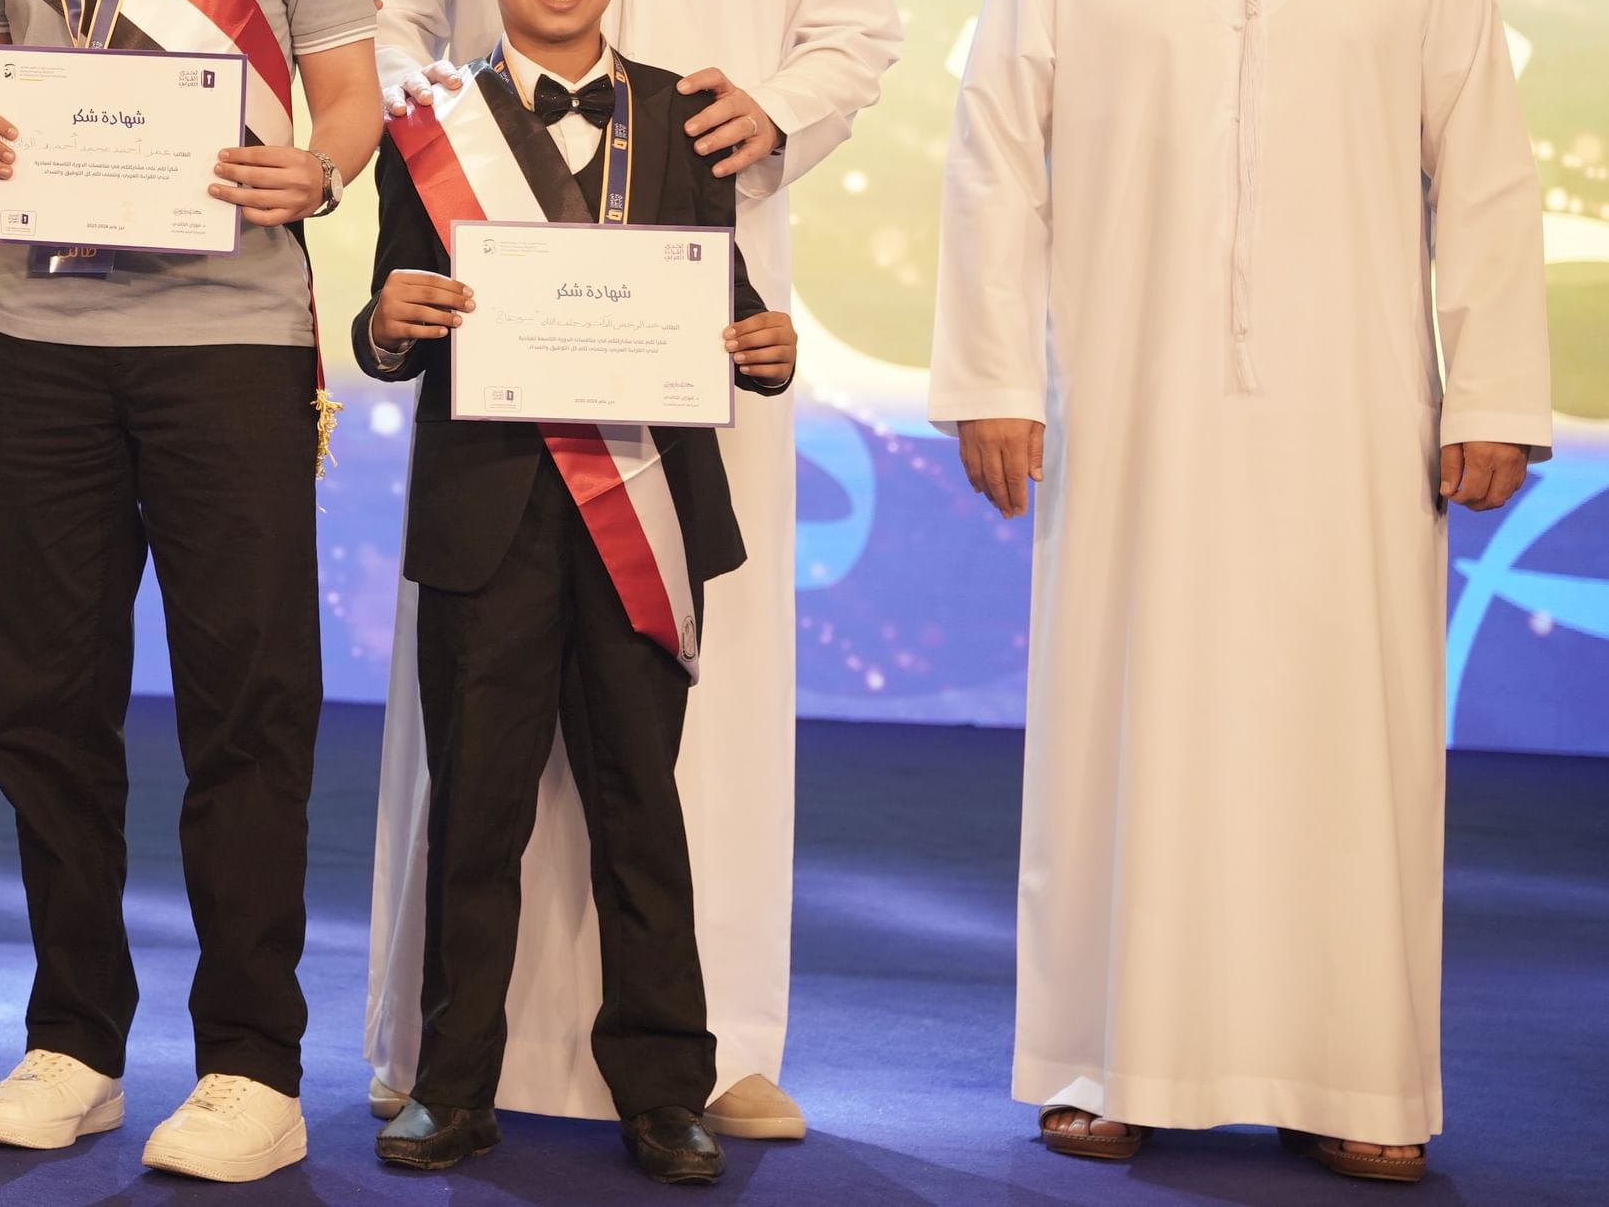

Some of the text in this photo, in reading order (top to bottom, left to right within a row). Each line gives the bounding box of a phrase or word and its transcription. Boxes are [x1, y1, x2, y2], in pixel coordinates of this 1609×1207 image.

[72, 108, 145, 129] شهادة شكر
[557, 282, 631, 302] شهادة شكر
